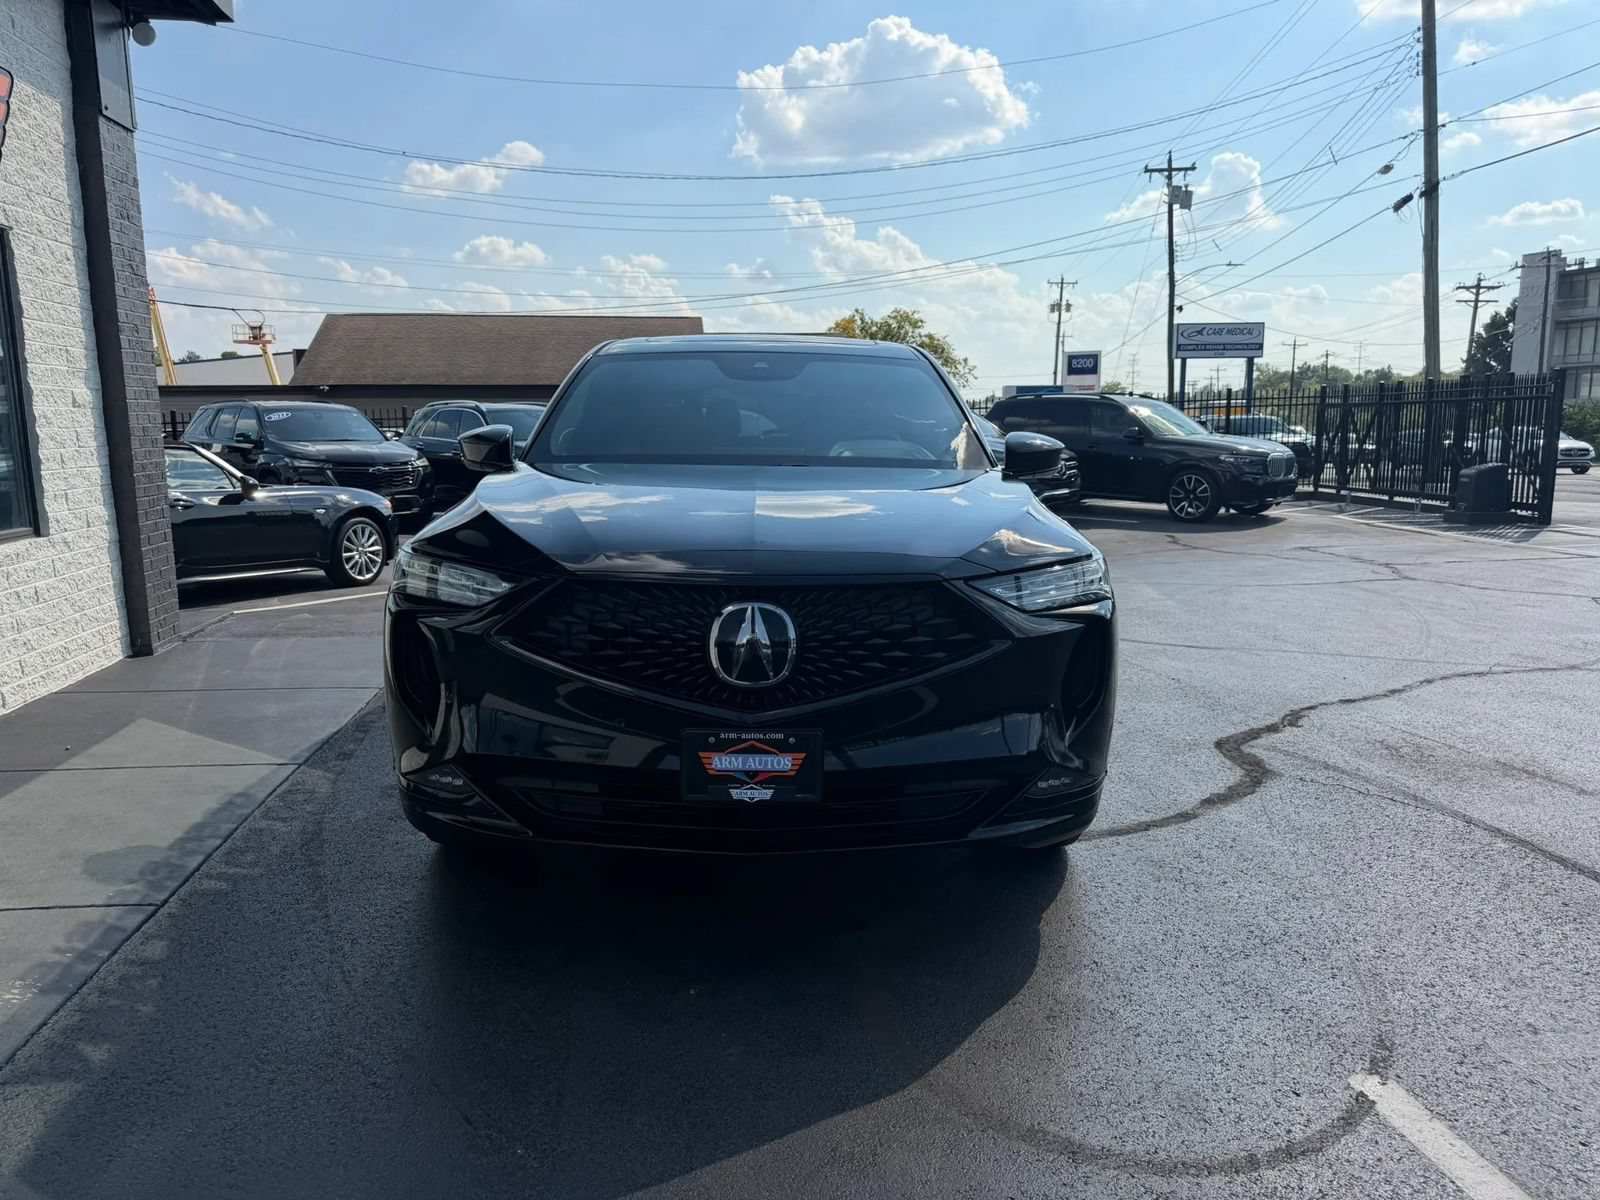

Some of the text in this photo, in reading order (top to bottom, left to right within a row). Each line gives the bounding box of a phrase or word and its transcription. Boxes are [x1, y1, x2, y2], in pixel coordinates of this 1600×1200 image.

[1206, 327, 1255, 336] CARE MEDICAL
[1071, 358, 1094, 368] 8200
[719, 732, 784, 740] arm-autos.com
[711, 756, 793, 769] ARM AUTOS
